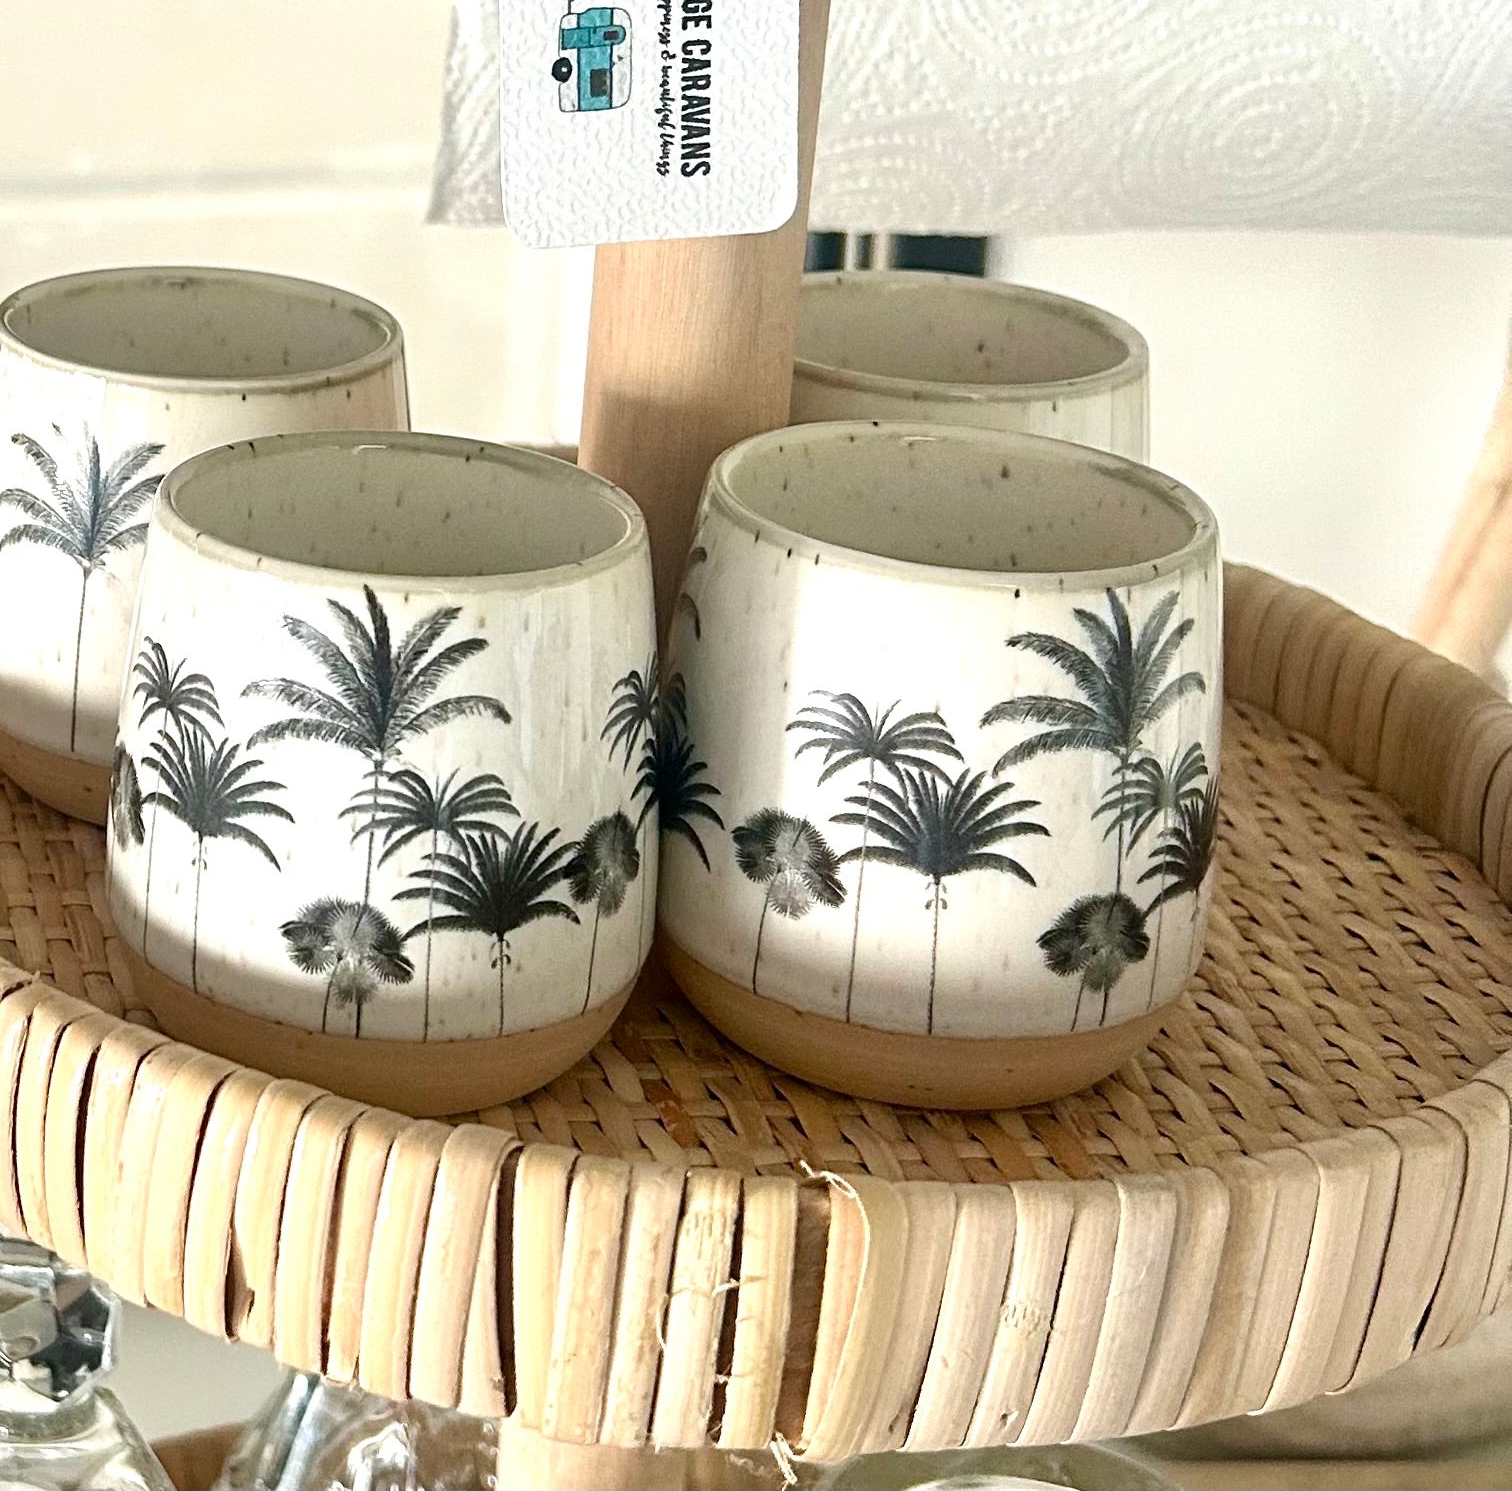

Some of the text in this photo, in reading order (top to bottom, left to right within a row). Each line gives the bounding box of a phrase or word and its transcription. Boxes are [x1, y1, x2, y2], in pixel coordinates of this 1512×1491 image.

[661, 48, 678, 63] &
[654, 64, 676, 131] beautiful
[680, 38, 713, 178] CARAVANS
[655, 132, 676, 178] things
